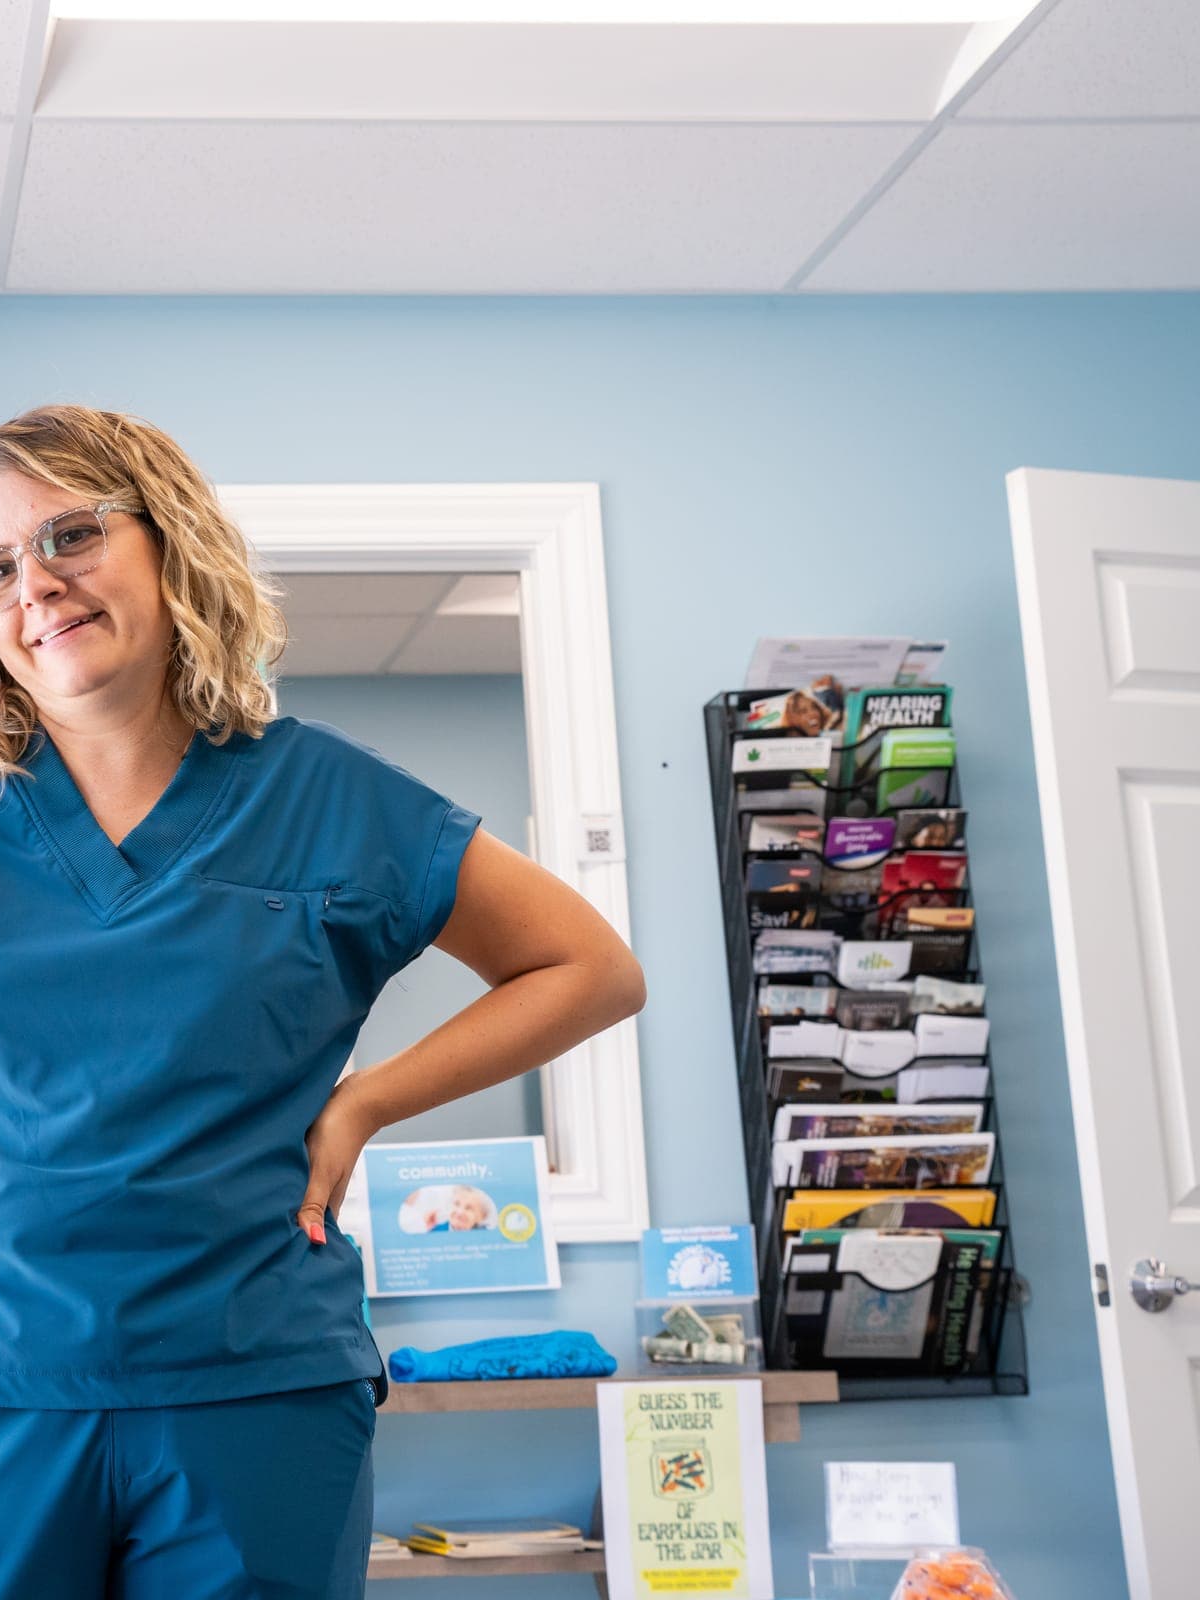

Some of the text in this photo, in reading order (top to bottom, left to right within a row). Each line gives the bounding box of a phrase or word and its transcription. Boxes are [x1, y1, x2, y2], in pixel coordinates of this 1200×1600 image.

[866, 694, 942, 712] HEARING
[870, 711, 935, 726] HEALTH
[399, 1161, 493, 1180] community.
[638, 1391, 723, 1411] GUESS THE
[650, 1411, 714, 1430] NUMBER
[676, 1501, 696, 1519] OF
[638, 1520, 737, 1541] EARPLUGS IN
[656, 1541, 723, 1561] THE JAR
